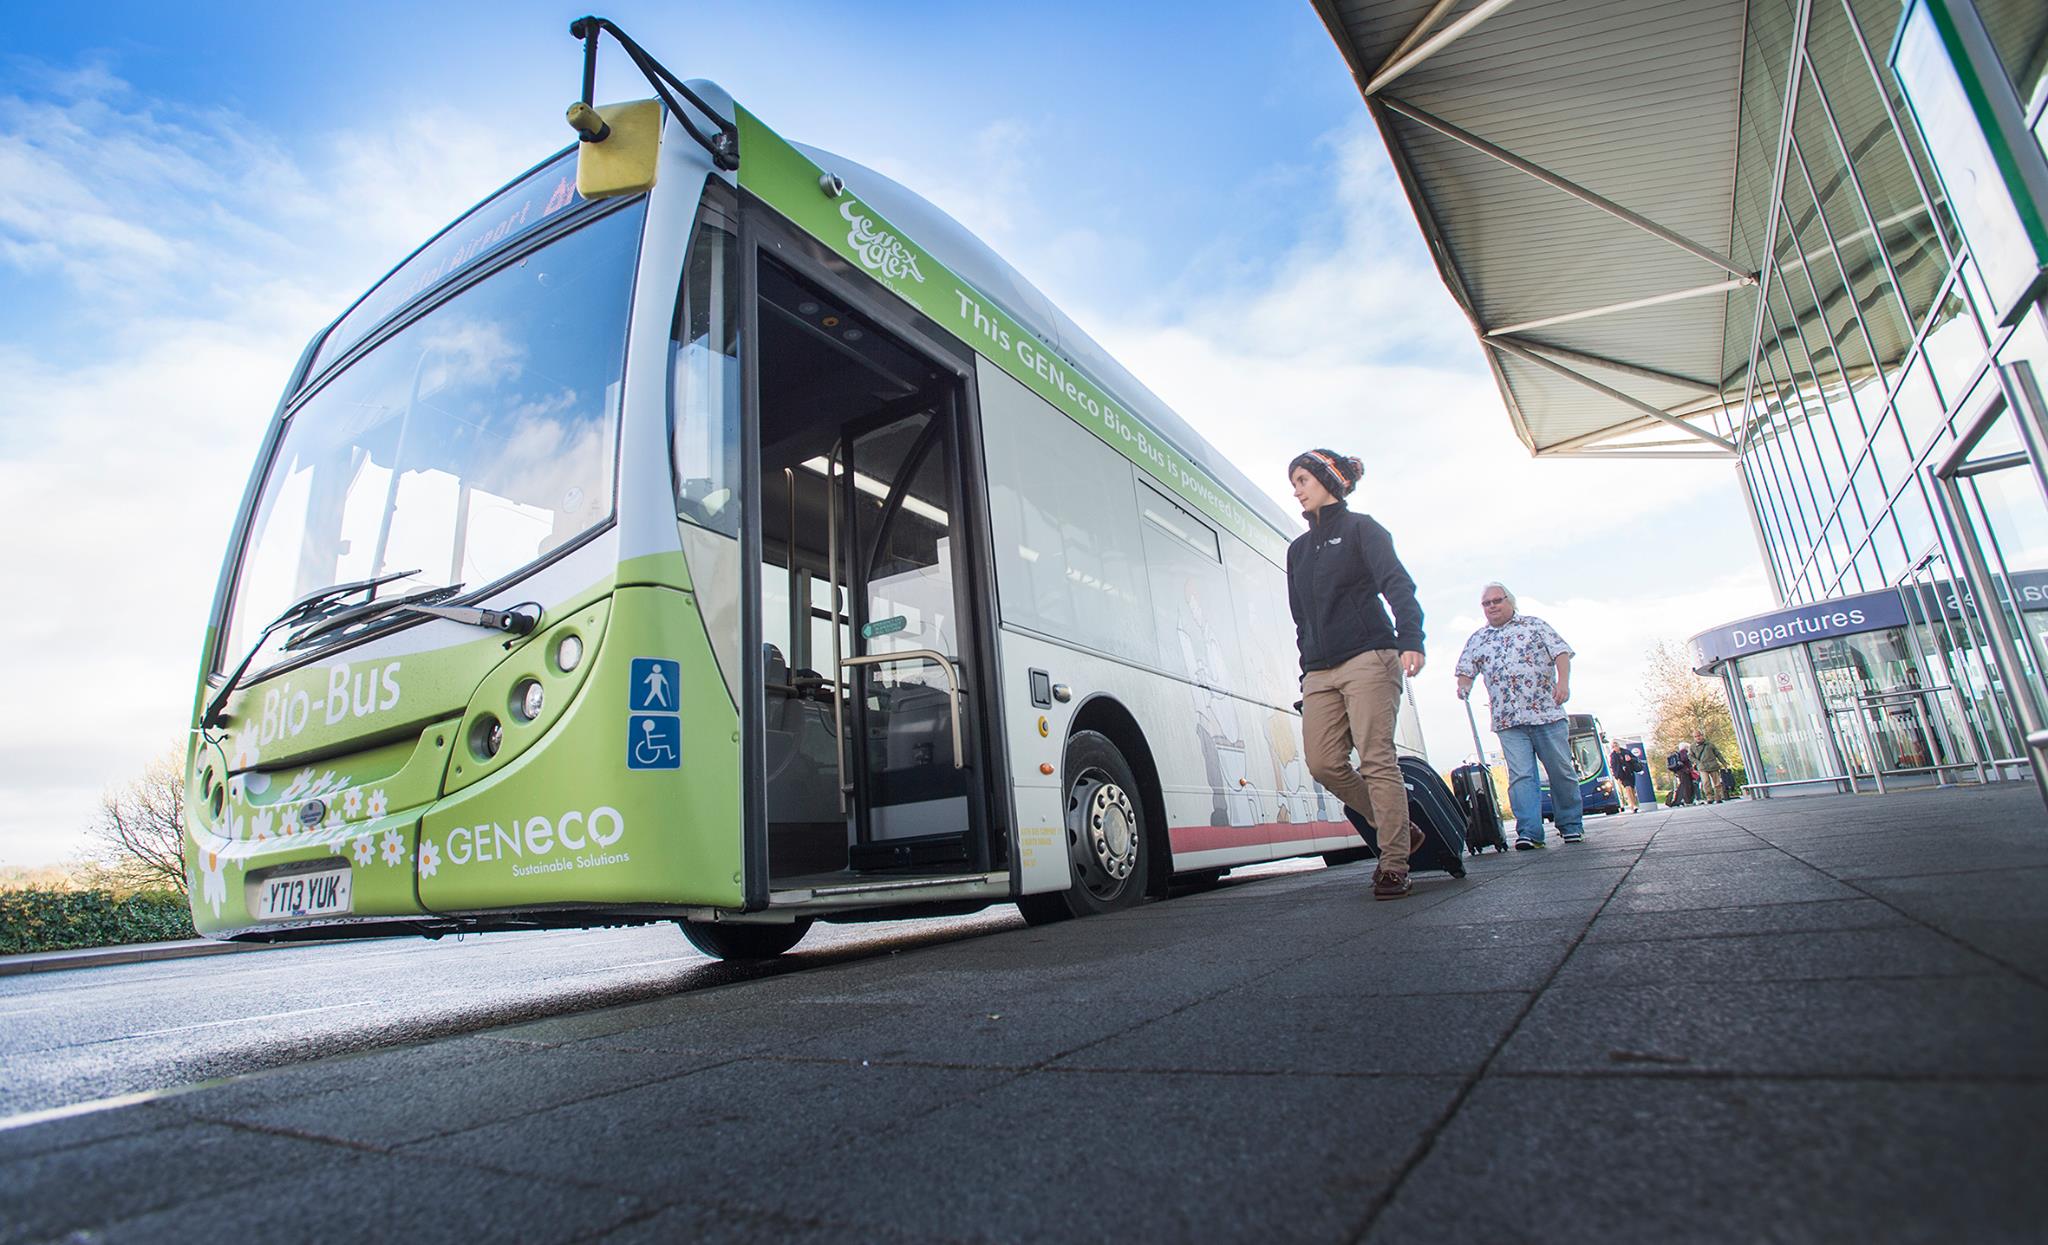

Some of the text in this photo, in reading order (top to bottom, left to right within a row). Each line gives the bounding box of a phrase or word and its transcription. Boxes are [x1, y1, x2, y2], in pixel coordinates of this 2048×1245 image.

[955, 288, 1011, 351] This
[1016, 340, 1100, 417] GENeco
[1103, 404, 1165, 468] Bio-Bus
[1166, 455, 1179, 478] is
[1181, 469, 1232, 519] powered
[1232, 508, 1246, 531] by
[1733, 609, 1866, 648] Departures
[260, 662, 401, 746] Bio-Bus
[446, 805, 625, 865] GENeco
[512, 852, 630, 877] Sustainable Solutions
[270, 875, 341, 913] YT13 YUK
